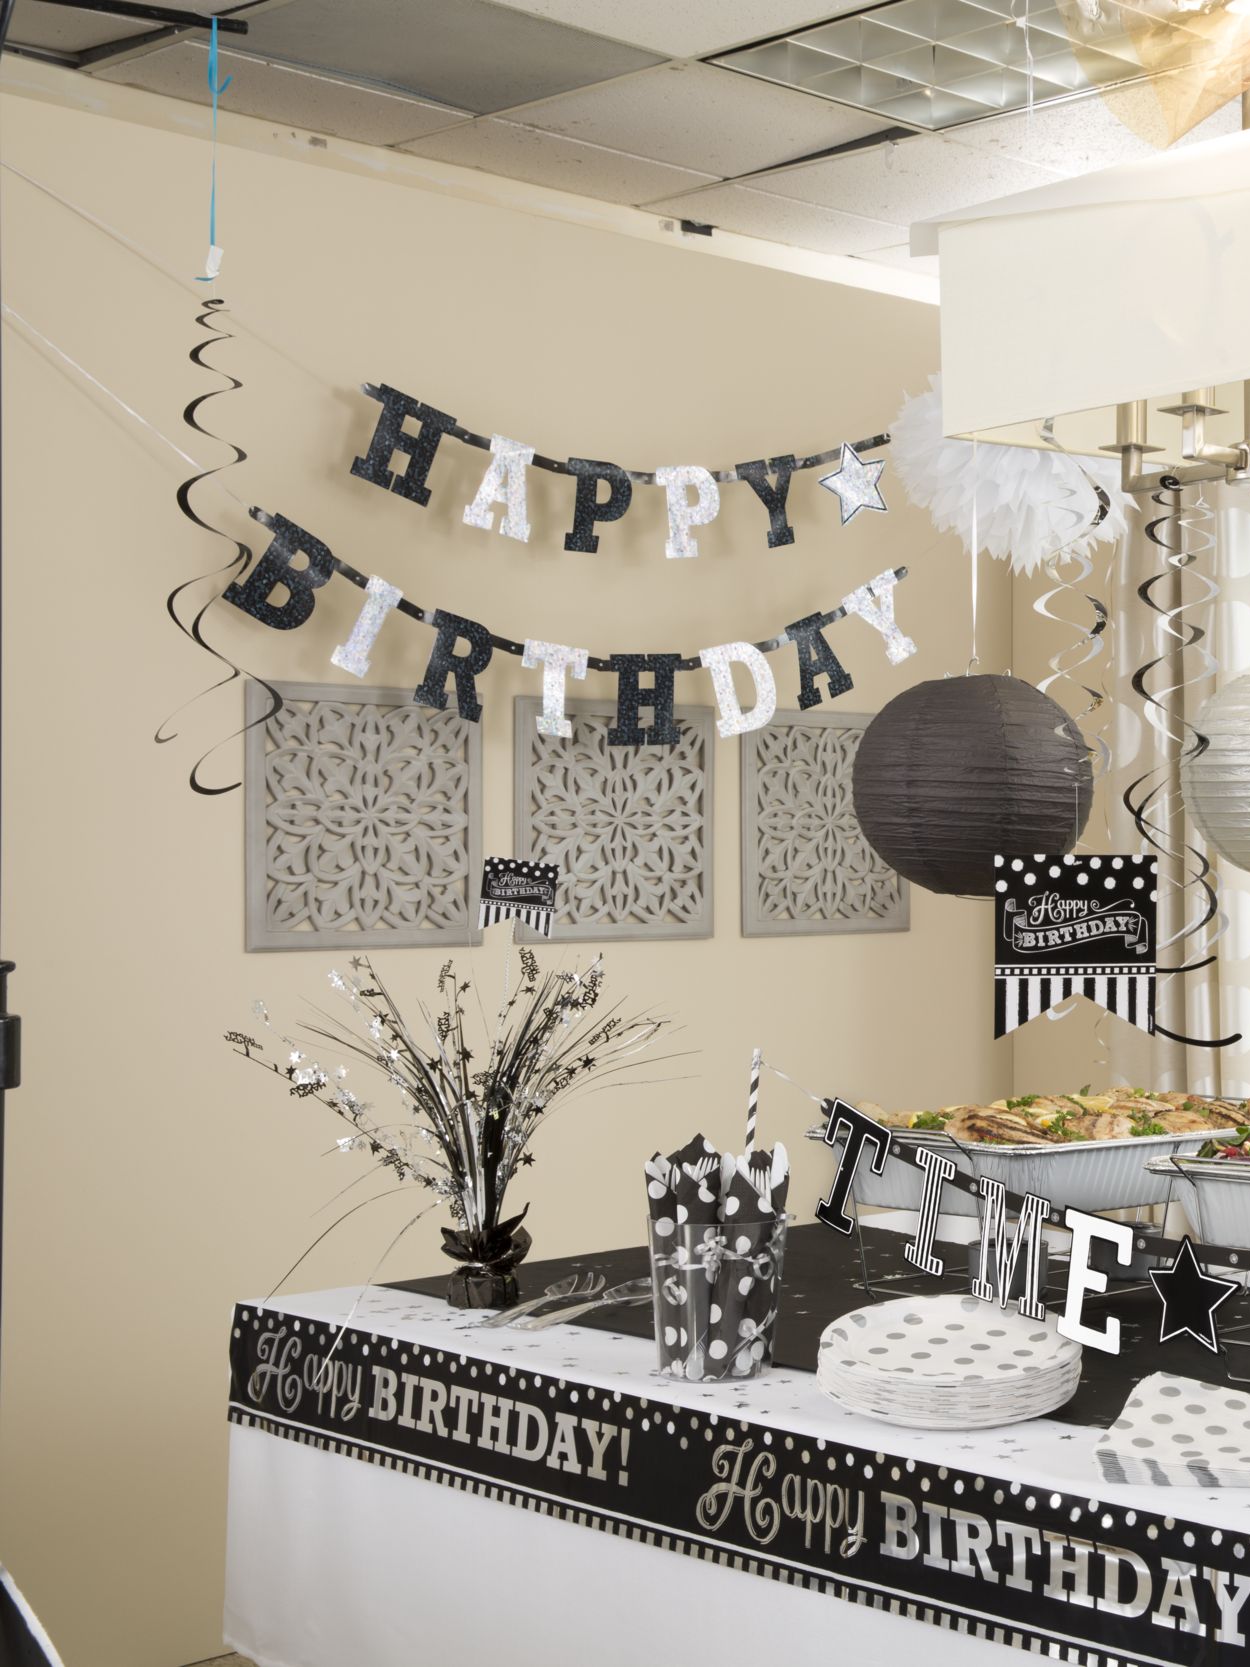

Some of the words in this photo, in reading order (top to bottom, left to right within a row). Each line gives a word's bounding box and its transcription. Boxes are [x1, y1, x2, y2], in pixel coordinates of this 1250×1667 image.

[350, 383, 797, 559] HAPPY
[221, 513, 918, 746] BIRTHDAY
[494, 886, 546, 896] BIRTHDAY
[1021, 915, 1131, 948] BIRTHDAY
[1028, 890, 1089, 925] Happy
[814, 1097, 1134, 1356] TIME
[248, 1326, 362, 1422] Happy
[367, 1364, 630, 1487] BIRTHDAY!
[695, 1438, 868, 1559] Happy
